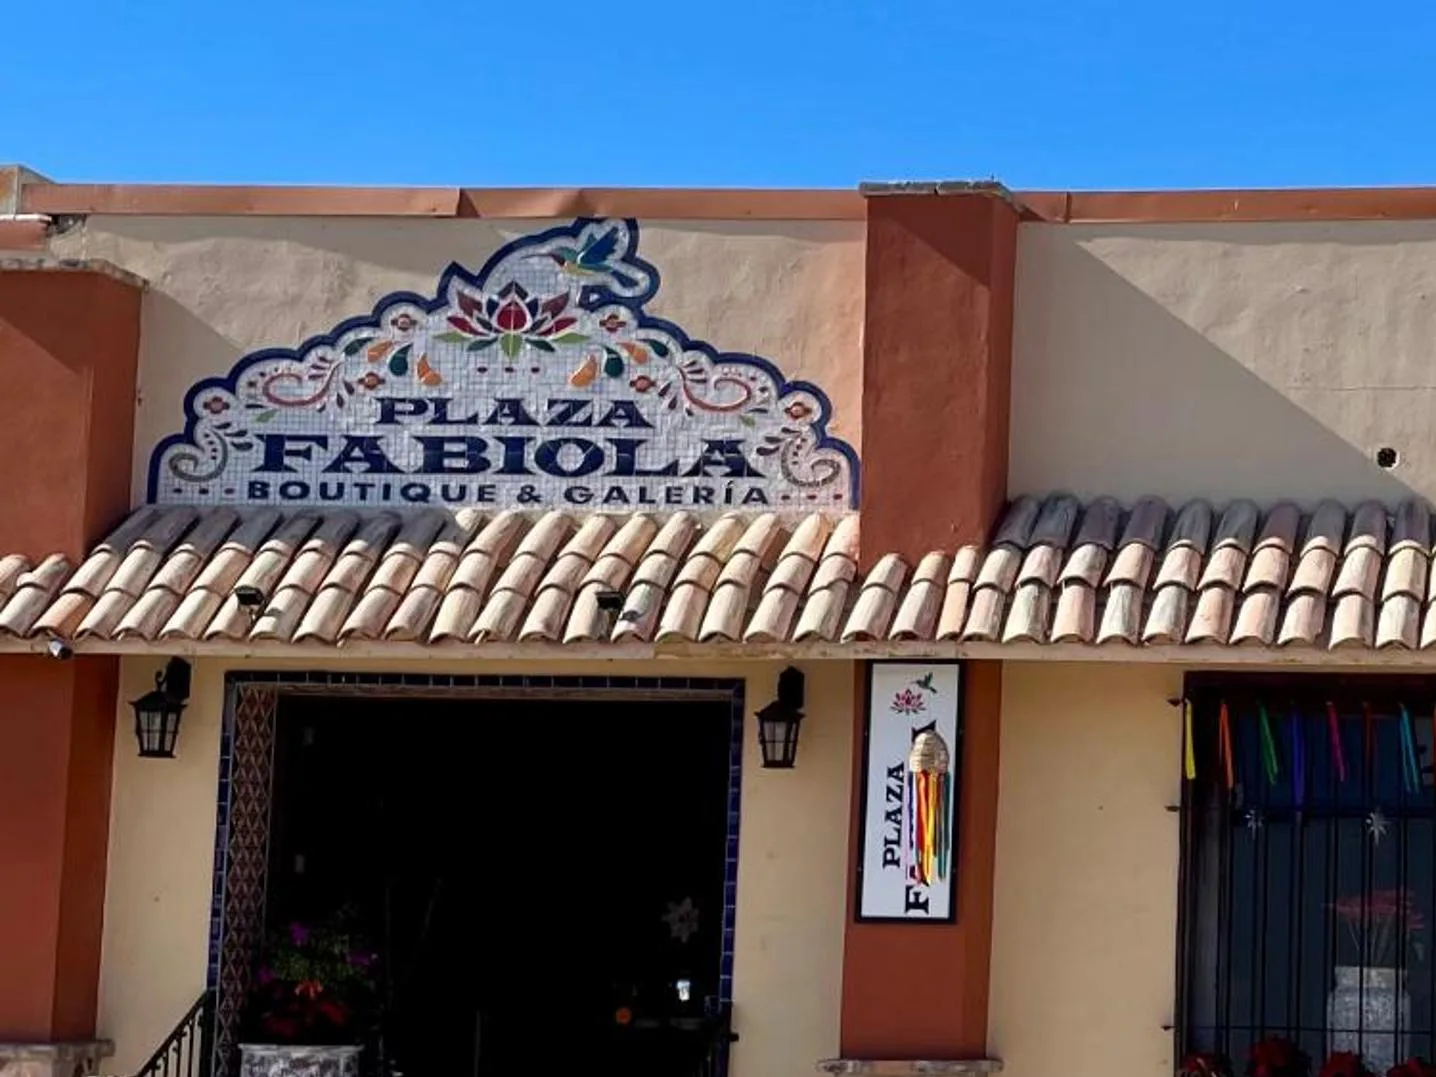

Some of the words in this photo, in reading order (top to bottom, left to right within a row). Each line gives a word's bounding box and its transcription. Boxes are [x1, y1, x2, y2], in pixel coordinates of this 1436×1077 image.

[374, 397, 655, 428] PLAZA
[252, 434, 766, 478] FABIOLA
[249, 480, 496, 503] BOUTIQUE
[516, 484, 542, 504] &
[563, 480, 769, 505] GALERÍA
[882, 761, 905, 868] PLAZA
